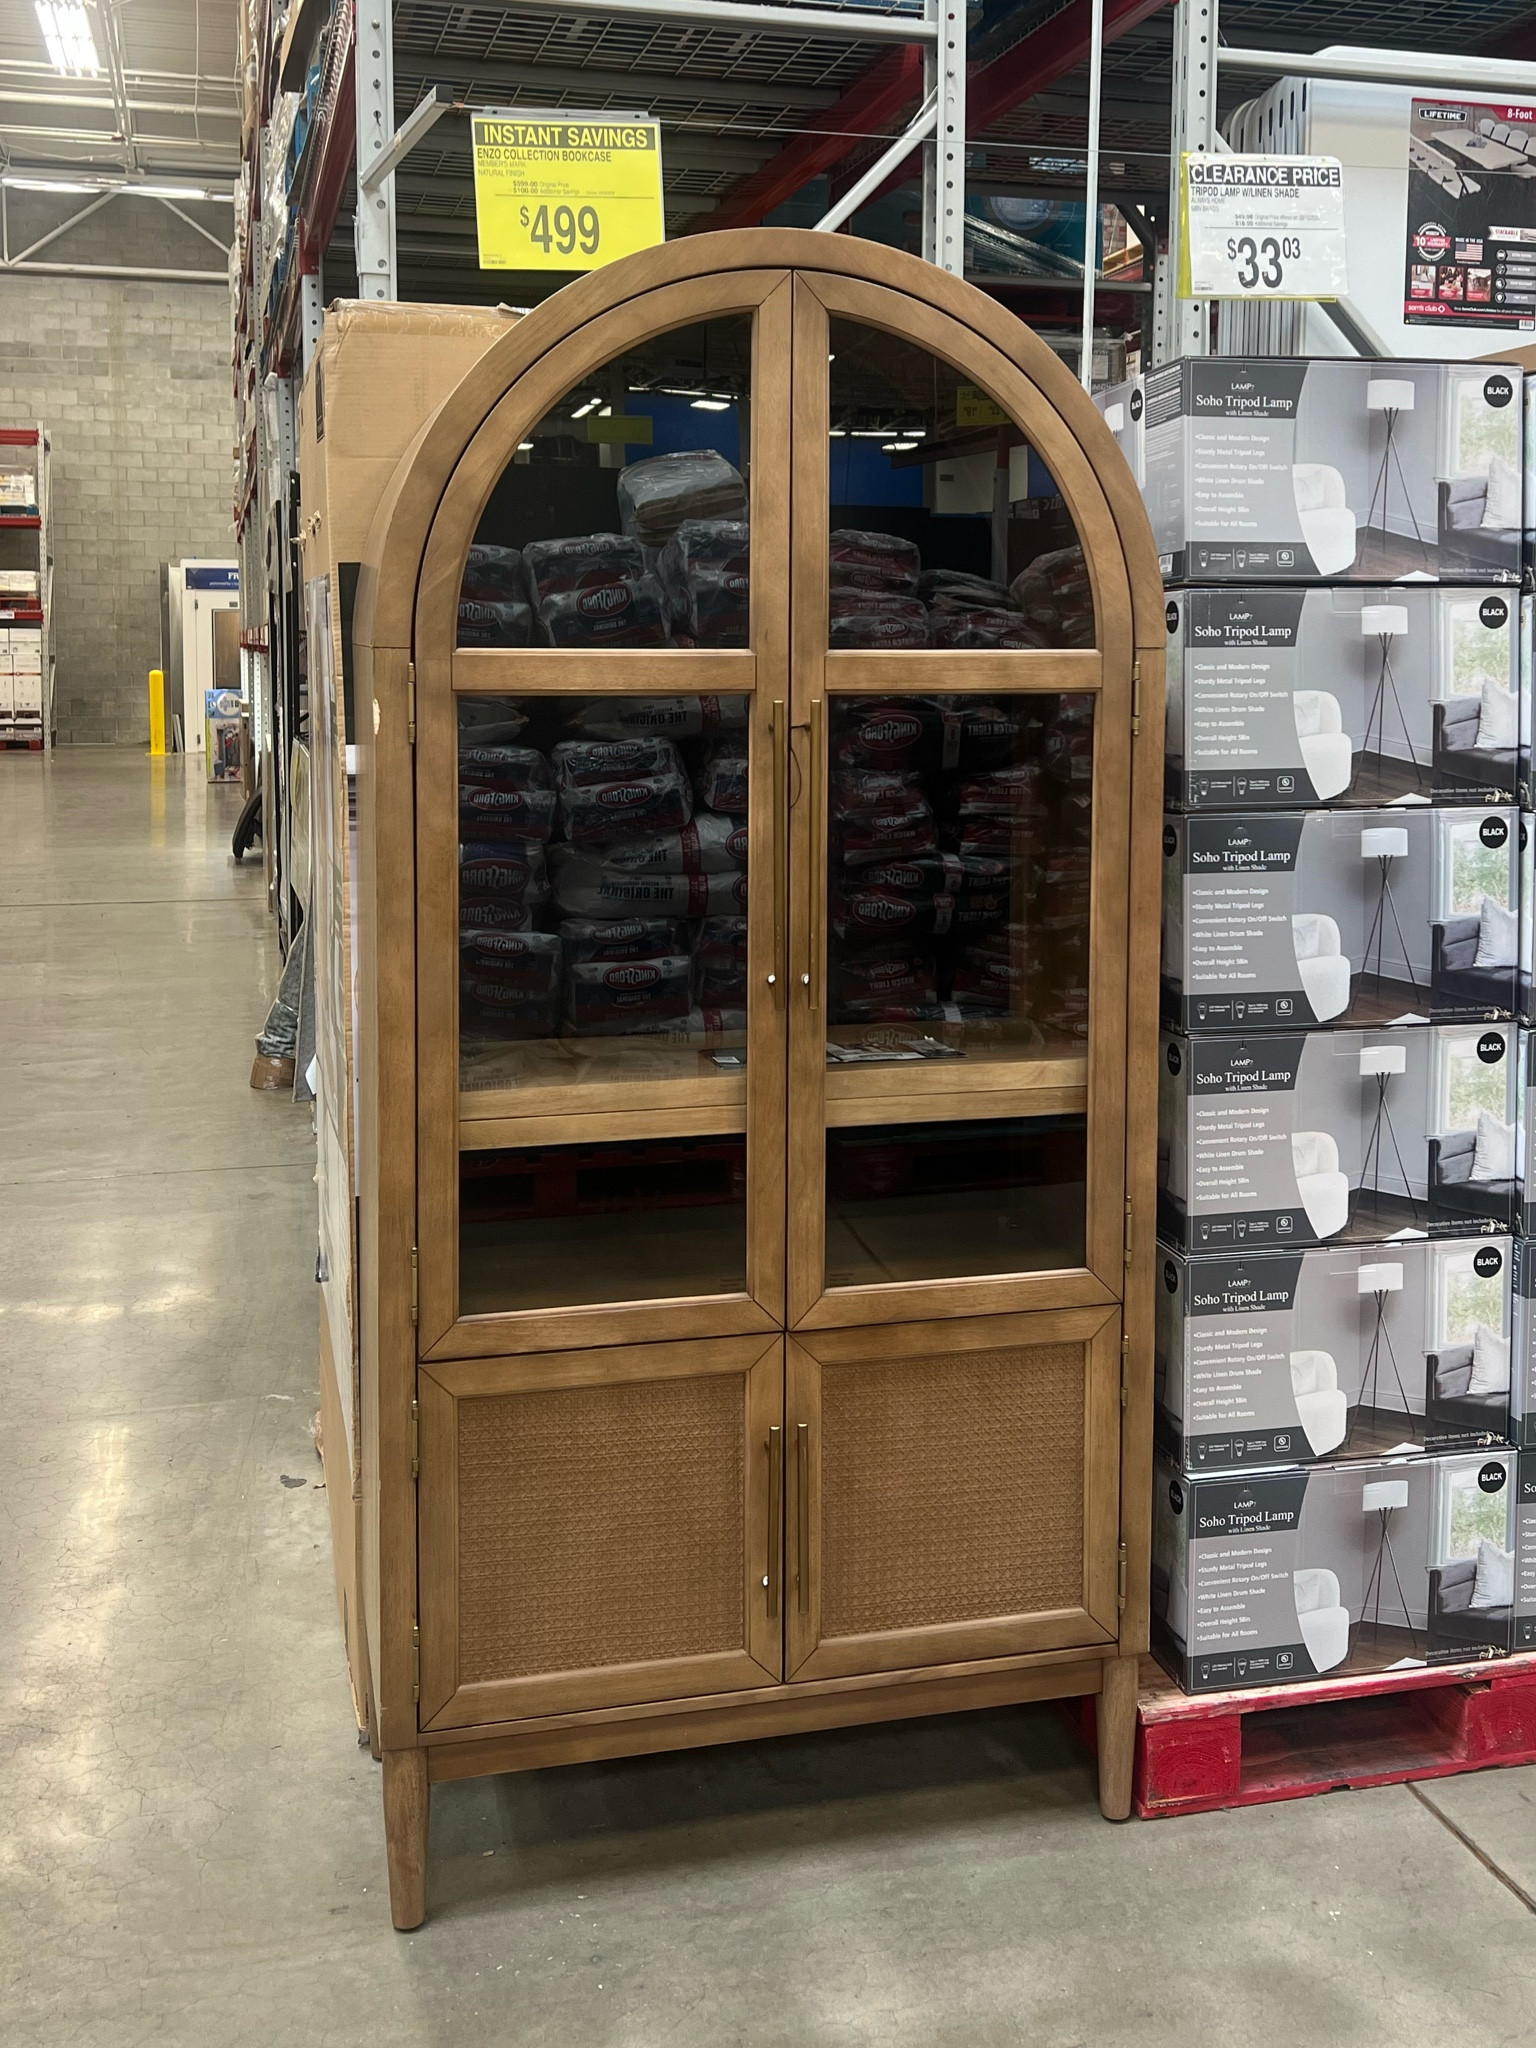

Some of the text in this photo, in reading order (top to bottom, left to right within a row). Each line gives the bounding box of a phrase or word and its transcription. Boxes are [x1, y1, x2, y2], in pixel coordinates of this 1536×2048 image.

[1424, 110, 1461, 120] LIFETIME
[1507, 109, 1532, 119] 8-Foot
[484, 125, 648, 147] INSTANT SAVINGS
[478, 149, 611, 161] ENZO COLLECTION BOOKCASE
[1191, 166, 1339, 185] CLEARANCE PRICE
[1191, 186, 1299, 198] TRIPOD LAMP W/LINEN SHADE
[520, 205, 599, 254] $499
[1416, 237, 1426, 246] 10
[1487, 387, 1508, 395] BLACK
[1196, 395, 1292, 410] Soho Tripod Lamp
[1482, 608, 1504, 616] BLACK
[1195, 626, 1291, 639] Soho Tripod Lamp
[1482, 828, 1504, 836] BLACK
[1193, 851, 1290, 864] Soho Tripod Lamp
[1480, 1044, 1501, 1052] BLACK
[1197, 1071, 1291, 1084] Soho Tripod Lamp
[1477, 1258, 1498, 1266] BLACK
[1194, 1291, 1289, 1305] Soho Tripod Lamp
[1481, 1473, 1502, 1481] BLACK
[1200, 1511, 1294, 1527] Soho Tripod Lamp
[1201, 1578, 1230, 1586] Convenient
[1220, 1603, 1245, 1611] Assemble
[1200, 1619, 1218, 1627] Overall
[1200, 1633, 1220, 1641] Suitable
